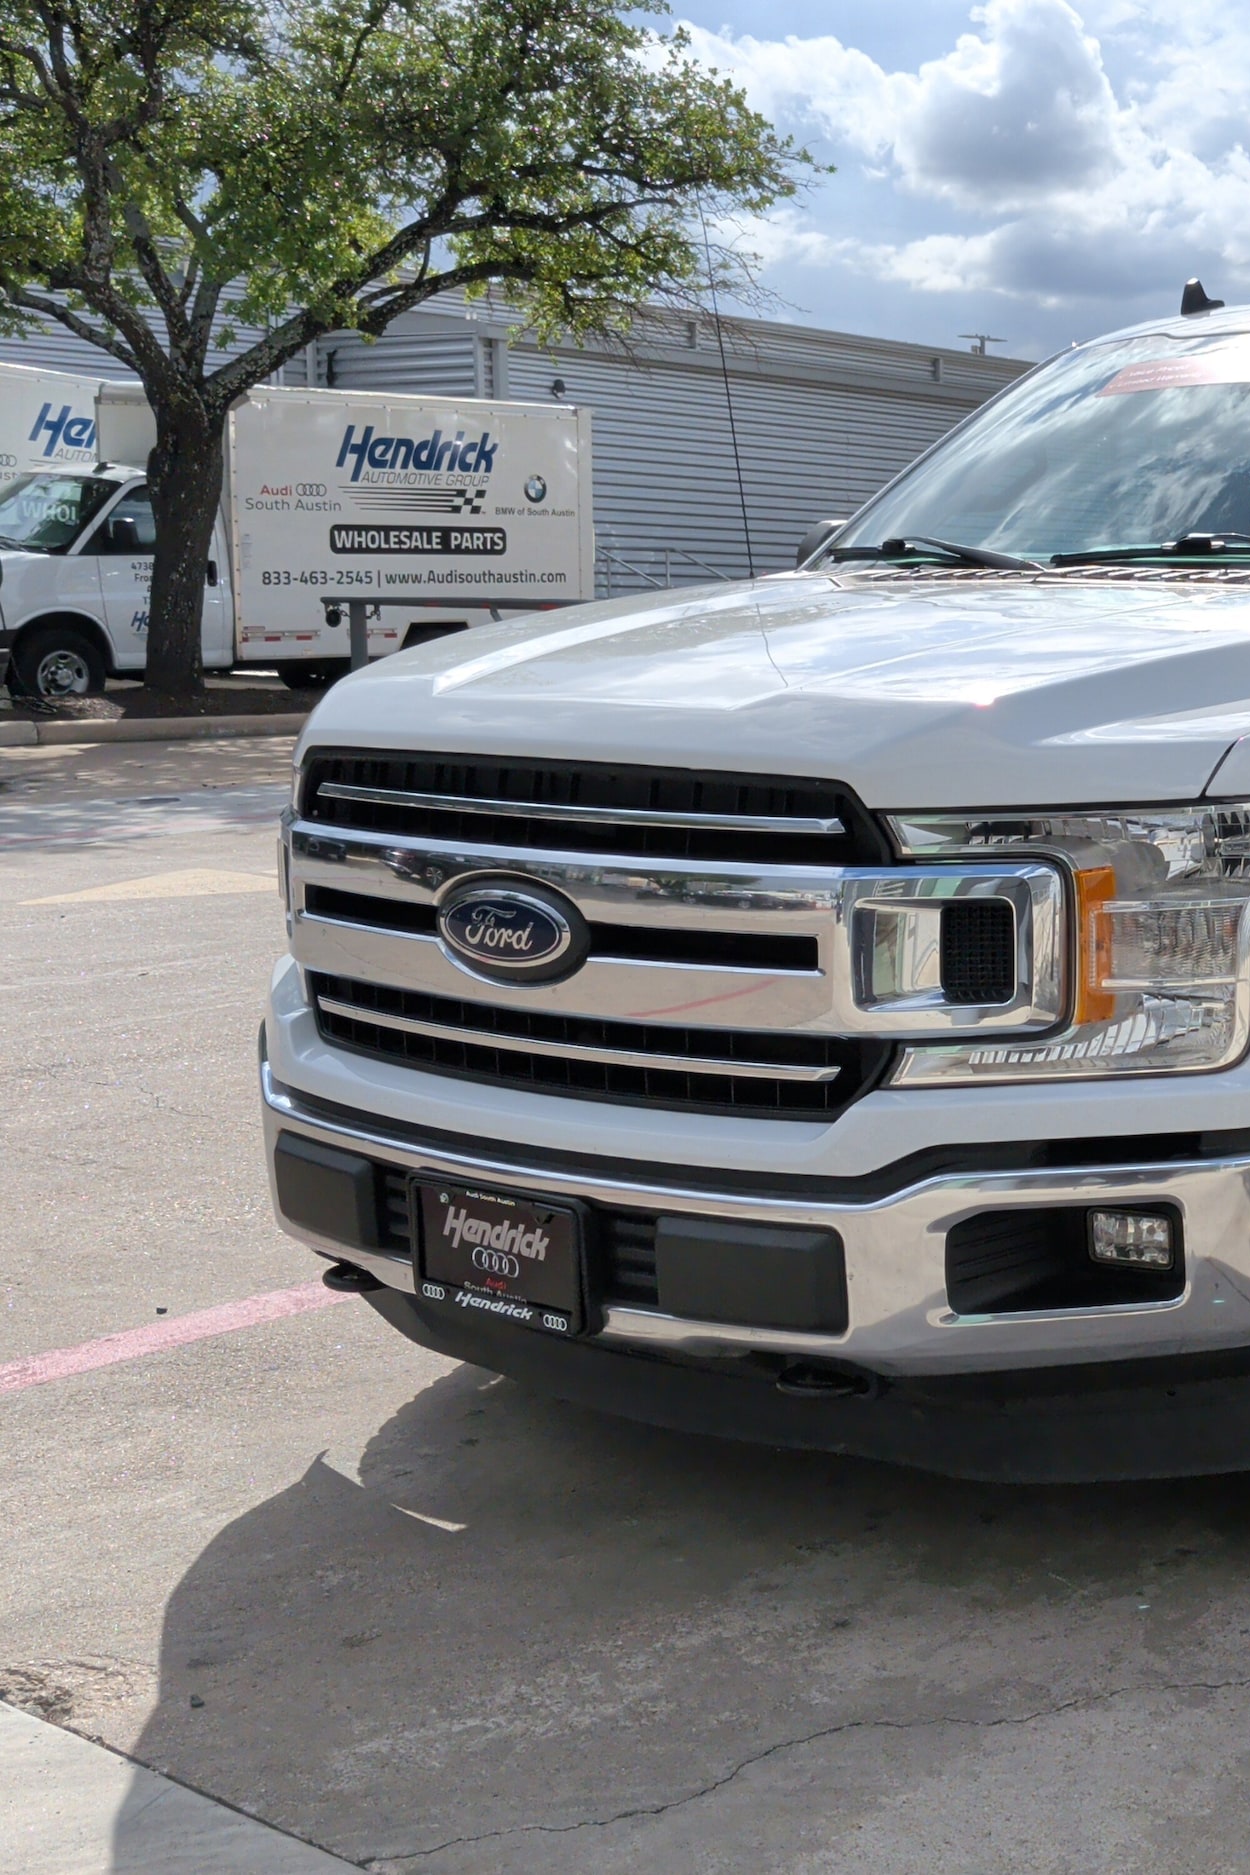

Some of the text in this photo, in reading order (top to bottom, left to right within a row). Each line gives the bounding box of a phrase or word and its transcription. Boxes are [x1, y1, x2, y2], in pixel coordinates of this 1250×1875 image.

[335, 424, 499, 483] Hendrick
[361, 471, 490, 487] AUTOMOTIVE GROUP
[260, 484, 293, 496] Audi
[245, 498, 342, 511] South Austin
[495, 508, 515, 516] BMW
[527, 509, 549, 517] South
[551, 510, 575, 518] Austin
[334, 530, 504, 550] WHOLESALE PARTS
[262, 571, 373, 585] 833-463-2545
[385, 570, 567, 584] www.Audisouthaustin.com
[465, 905, 535, 950] Ford
[443, 1206, 549, 1261] Hendrick
[463, 1280, 493, 1295] South
[485, 1278, 506, 1289] Audi
[455, 1291, 532, 1320] Hendrick
